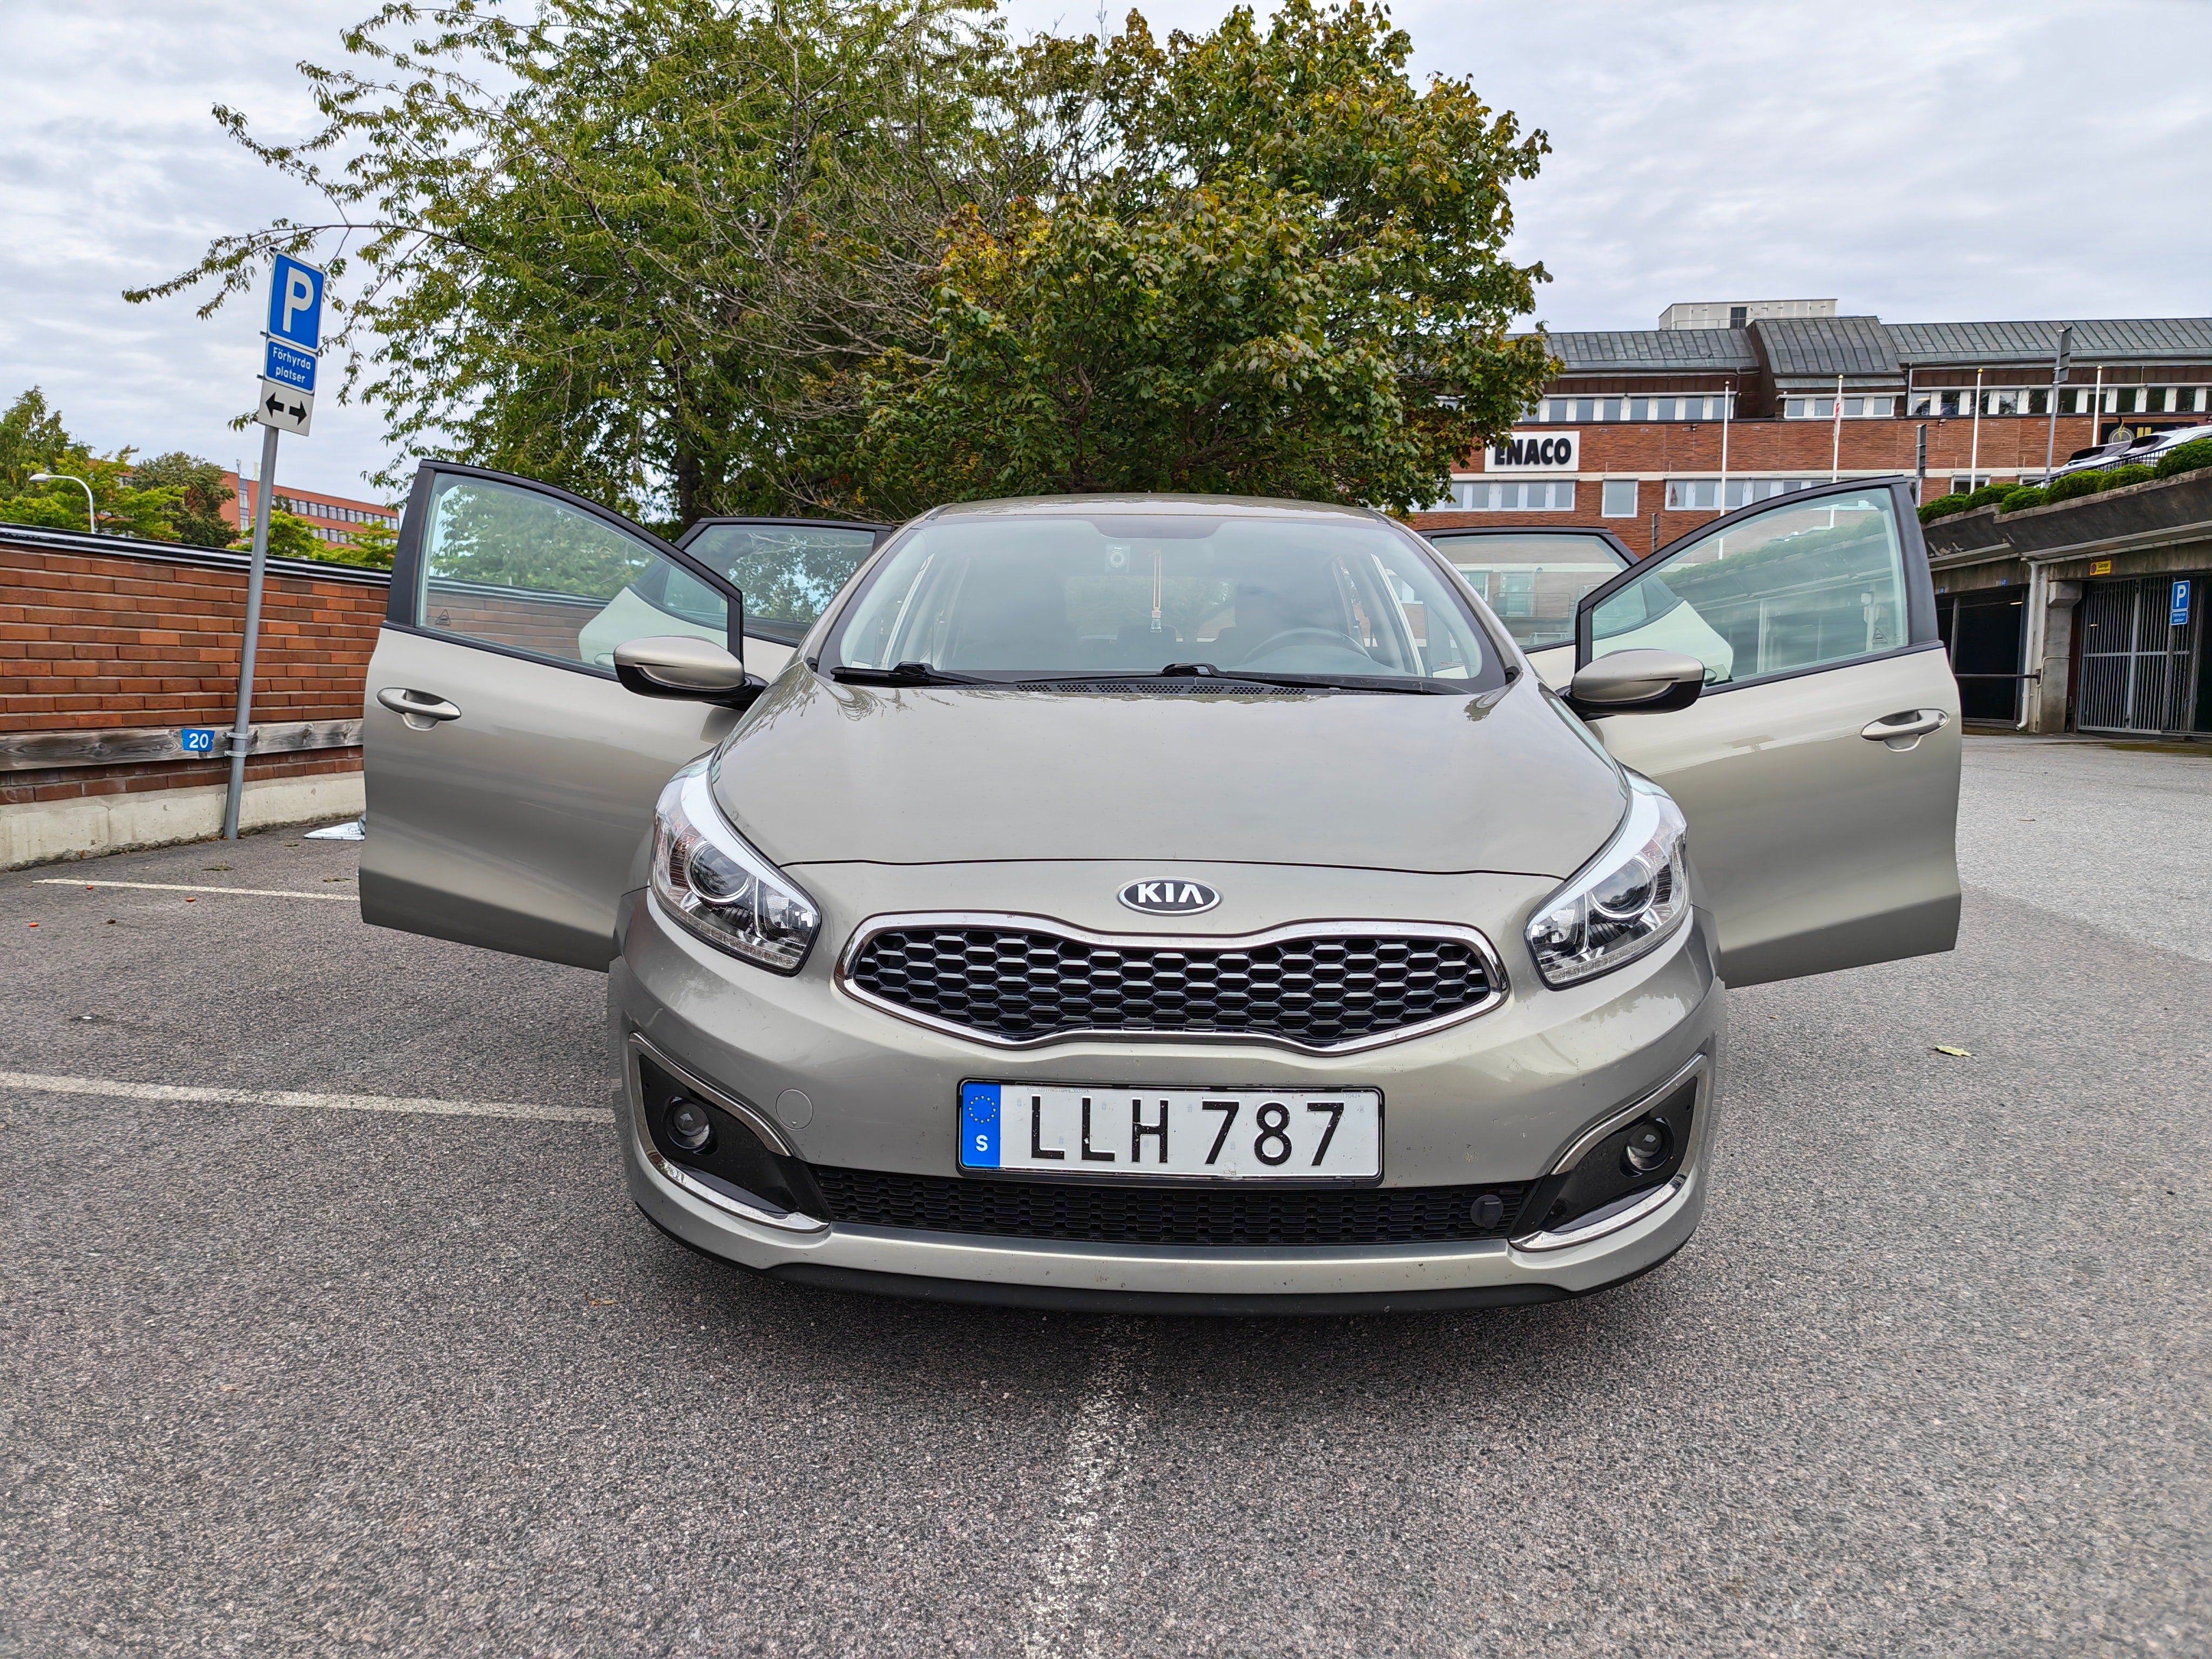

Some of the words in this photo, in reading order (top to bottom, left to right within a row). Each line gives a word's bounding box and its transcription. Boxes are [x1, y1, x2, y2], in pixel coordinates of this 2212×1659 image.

[282, 266, 314, 333] P
[272, 346, 311, 370] Förhyrda
[275, 365, 306, 384] platser
[1494, 438, 1572, 465] ENACO
[2176, 584, 2187, 608] P
[188, 733, 209, 748] 20
[1136, 882, 1204, 905] KIA
[976, 1134, 988, 1151] S
[1030, 1095, 1169, 1164] LLH
[1201, 1100, 1345, 1167] 787
